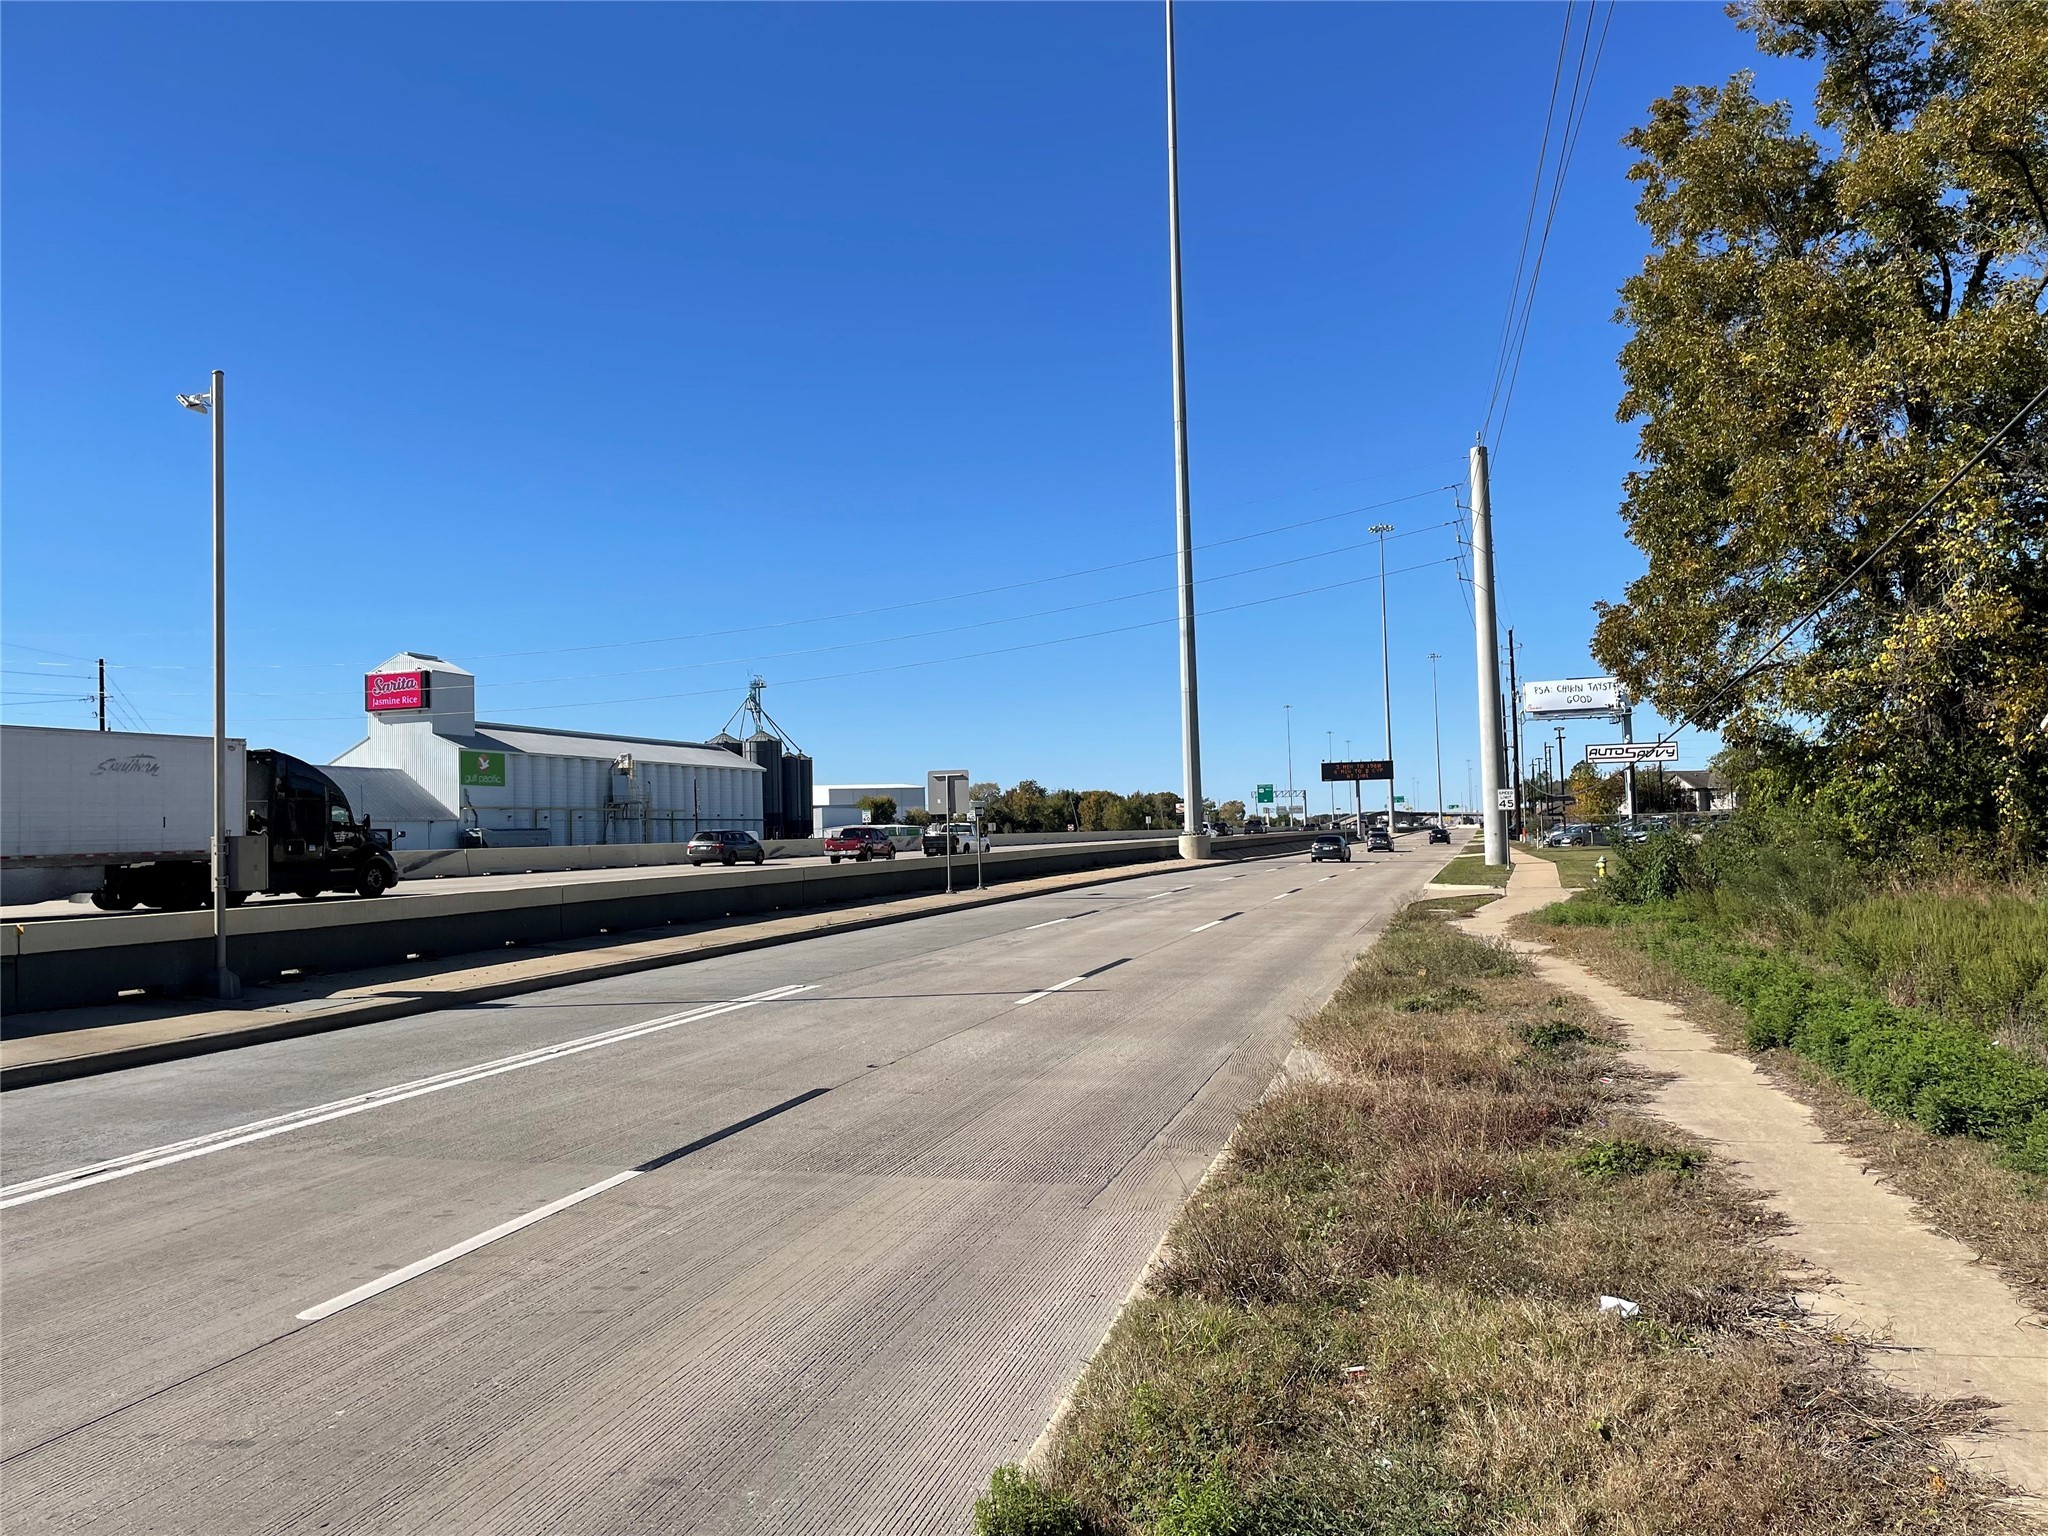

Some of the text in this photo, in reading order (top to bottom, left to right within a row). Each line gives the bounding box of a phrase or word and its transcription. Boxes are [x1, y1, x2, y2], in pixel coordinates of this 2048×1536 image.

[372, 677, 417, 696] Sarita
[373, 696, 418, 707] Jasmine Rice
[1567, 694, 1593, 703] GOOD
[90, 754, 160, 776] Southern
[465, 774, 477, 783] gulf
